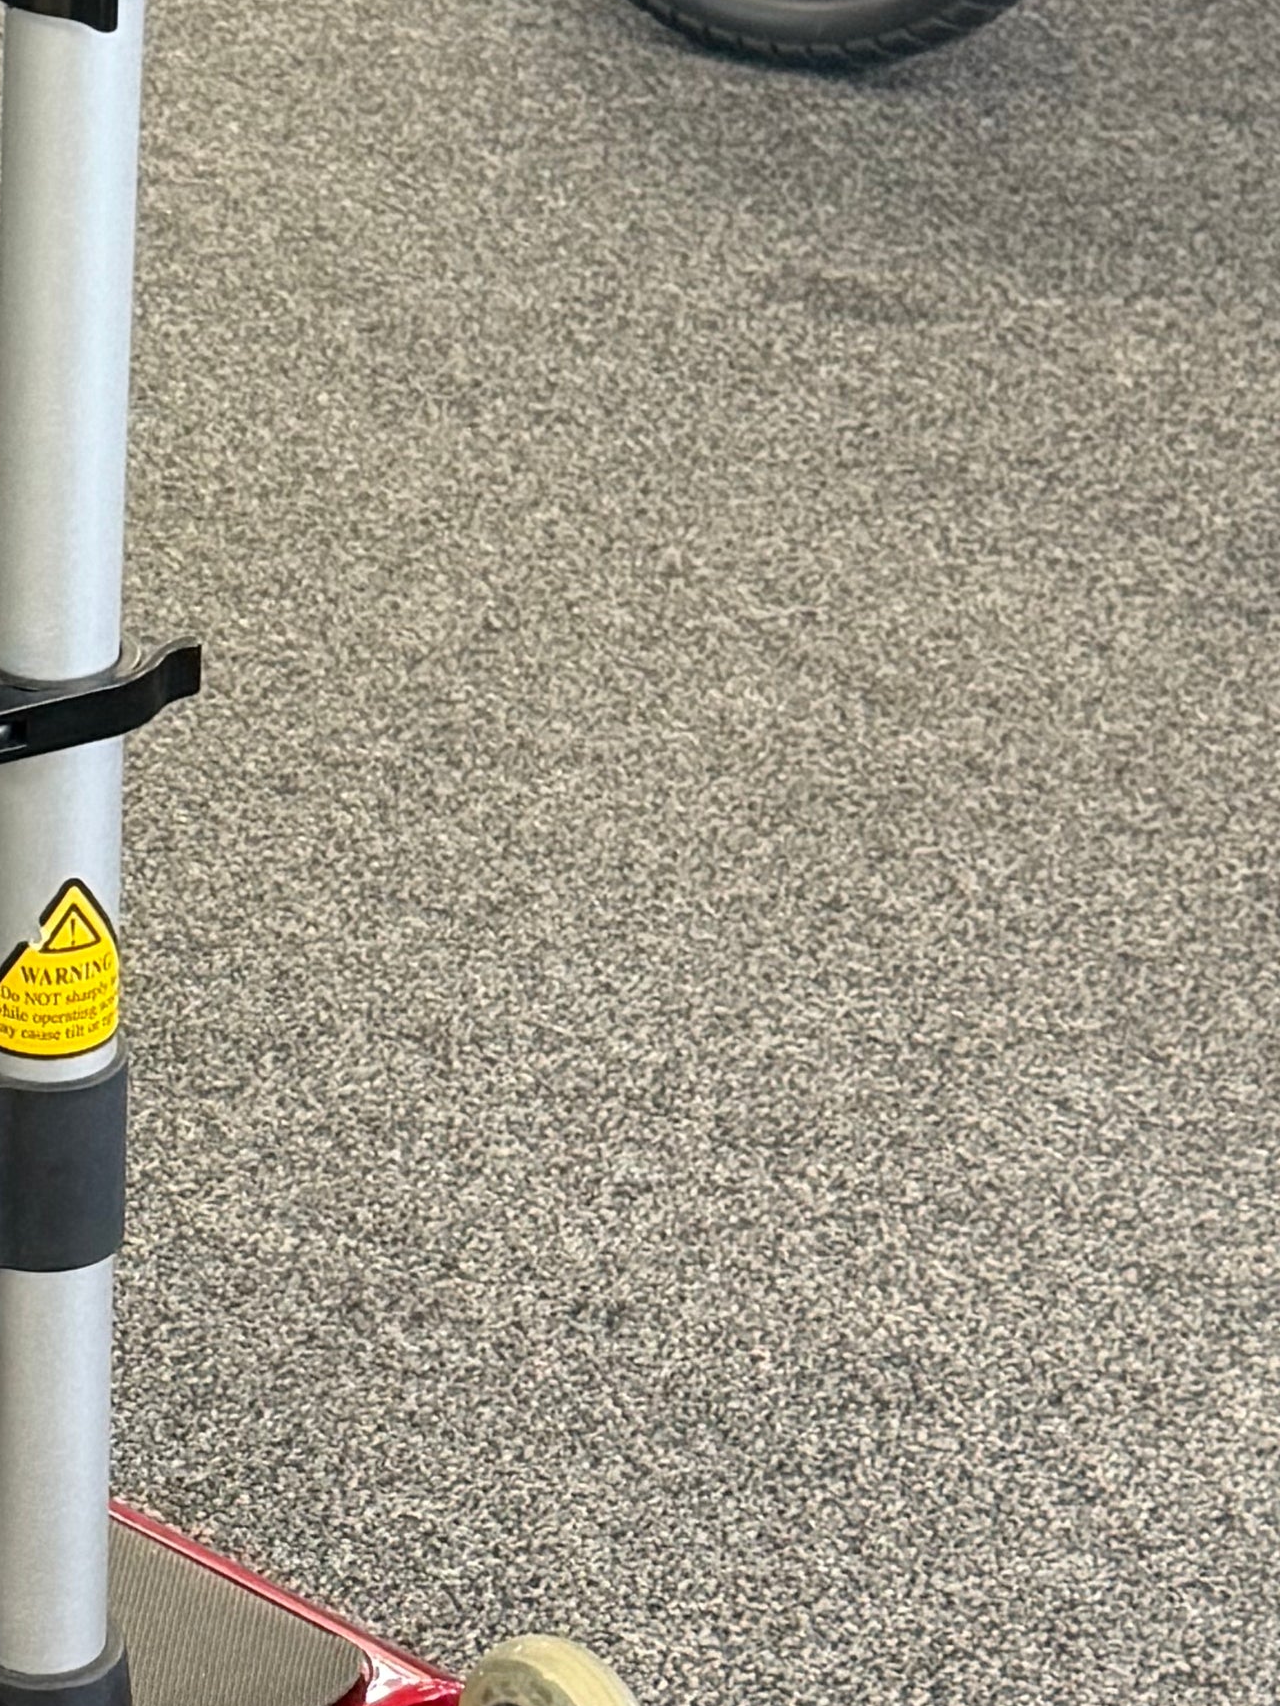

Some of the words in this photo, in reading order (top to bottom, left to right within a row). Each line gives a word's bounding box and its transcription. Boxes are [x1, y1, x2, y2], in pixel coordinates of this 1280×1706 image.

[20, 952, 111, 986] WARNING
[1, 984, 20, 1002] Do
[24, 991, 61, 1006] NOT
[32, 1005, 97, 1027] operating
[21, 1029, 61, 1041] cause
[65, 1023, 85, 1039] tilt
